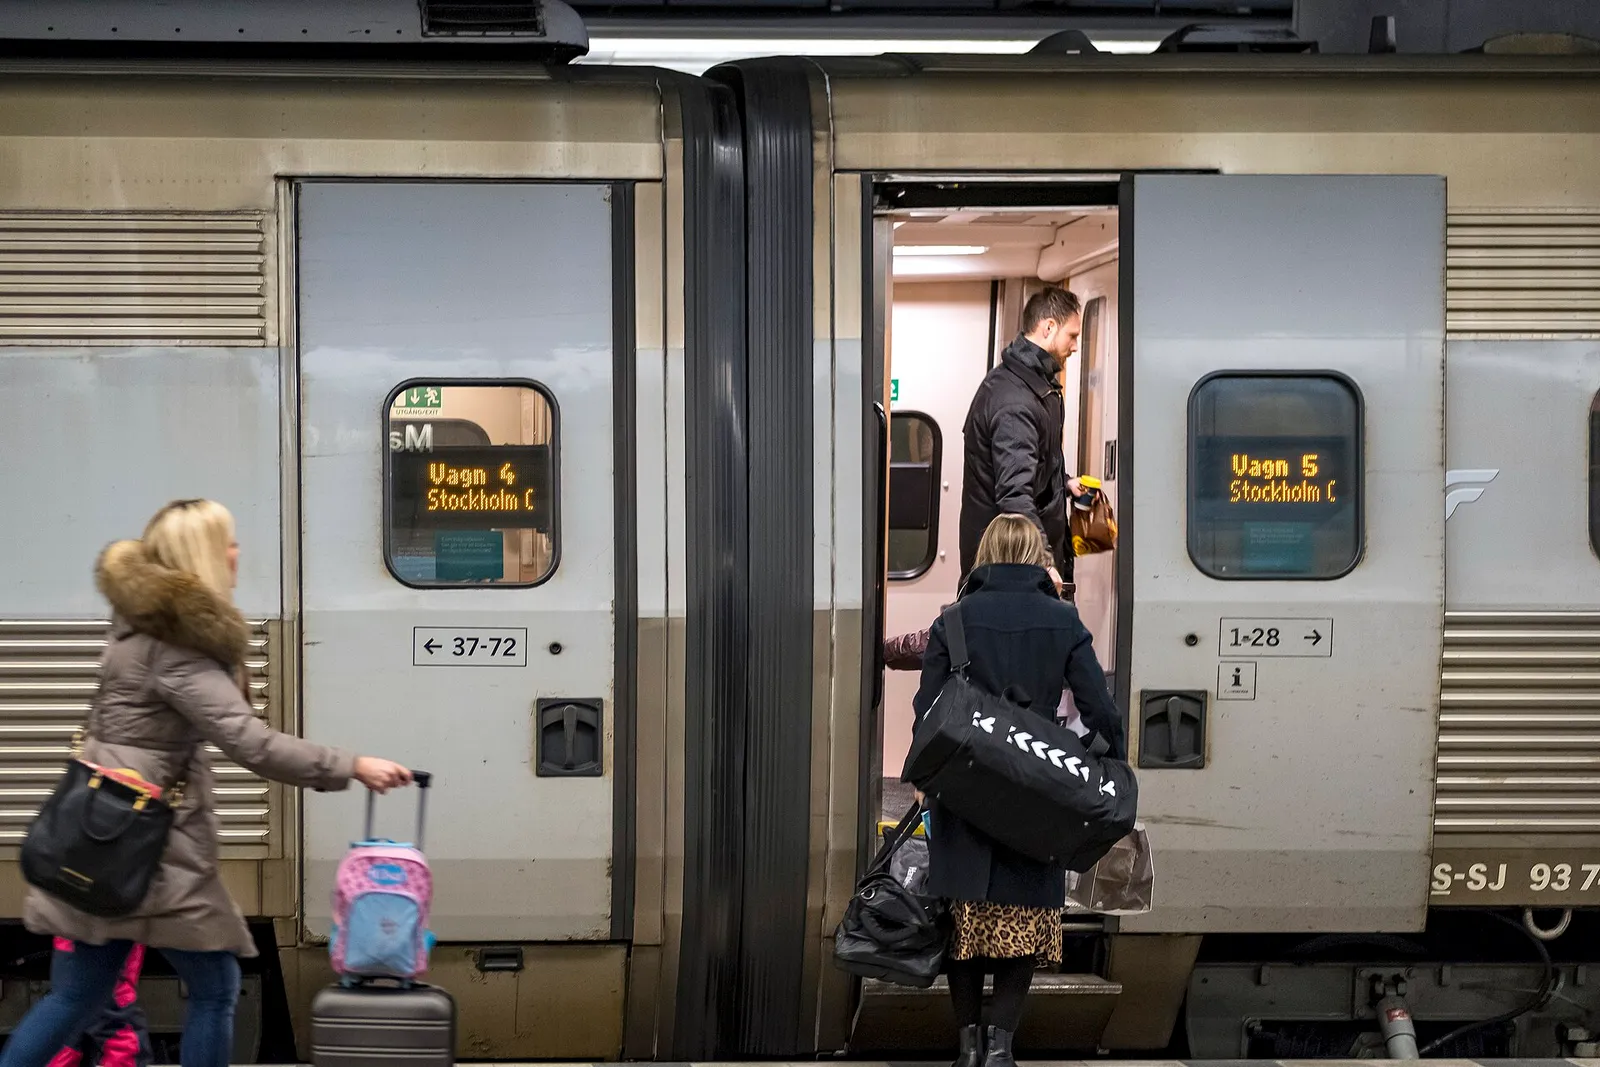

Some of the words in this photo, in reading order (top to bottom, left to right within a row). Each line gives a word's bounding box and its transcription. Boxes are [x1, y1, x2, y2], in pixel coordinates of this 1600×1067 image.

[396, 407, 438, 416] UTGÅNG/EXIT
[429, 462, 487, 488] Vagn
[500, 462, 516, 486] 4
[1231, 454, 1289, 479] Vagn
[1301, 454, 1319, 478] 5
[427, 488, 518, 511] Stockholm
[525, 488, 534, 510] C
[1229, 479, 1320, 503] Stockholm
[1326, 479, 1337, 503] C
[452, 636, 517, 657] 37-72
[1229, 627, 1280, 647] 1-28
[1431, 862, 1507, 895] S-SJ
[1529, 862, 1572, 892] 93
[1579, 863, 1600, 891] 7
